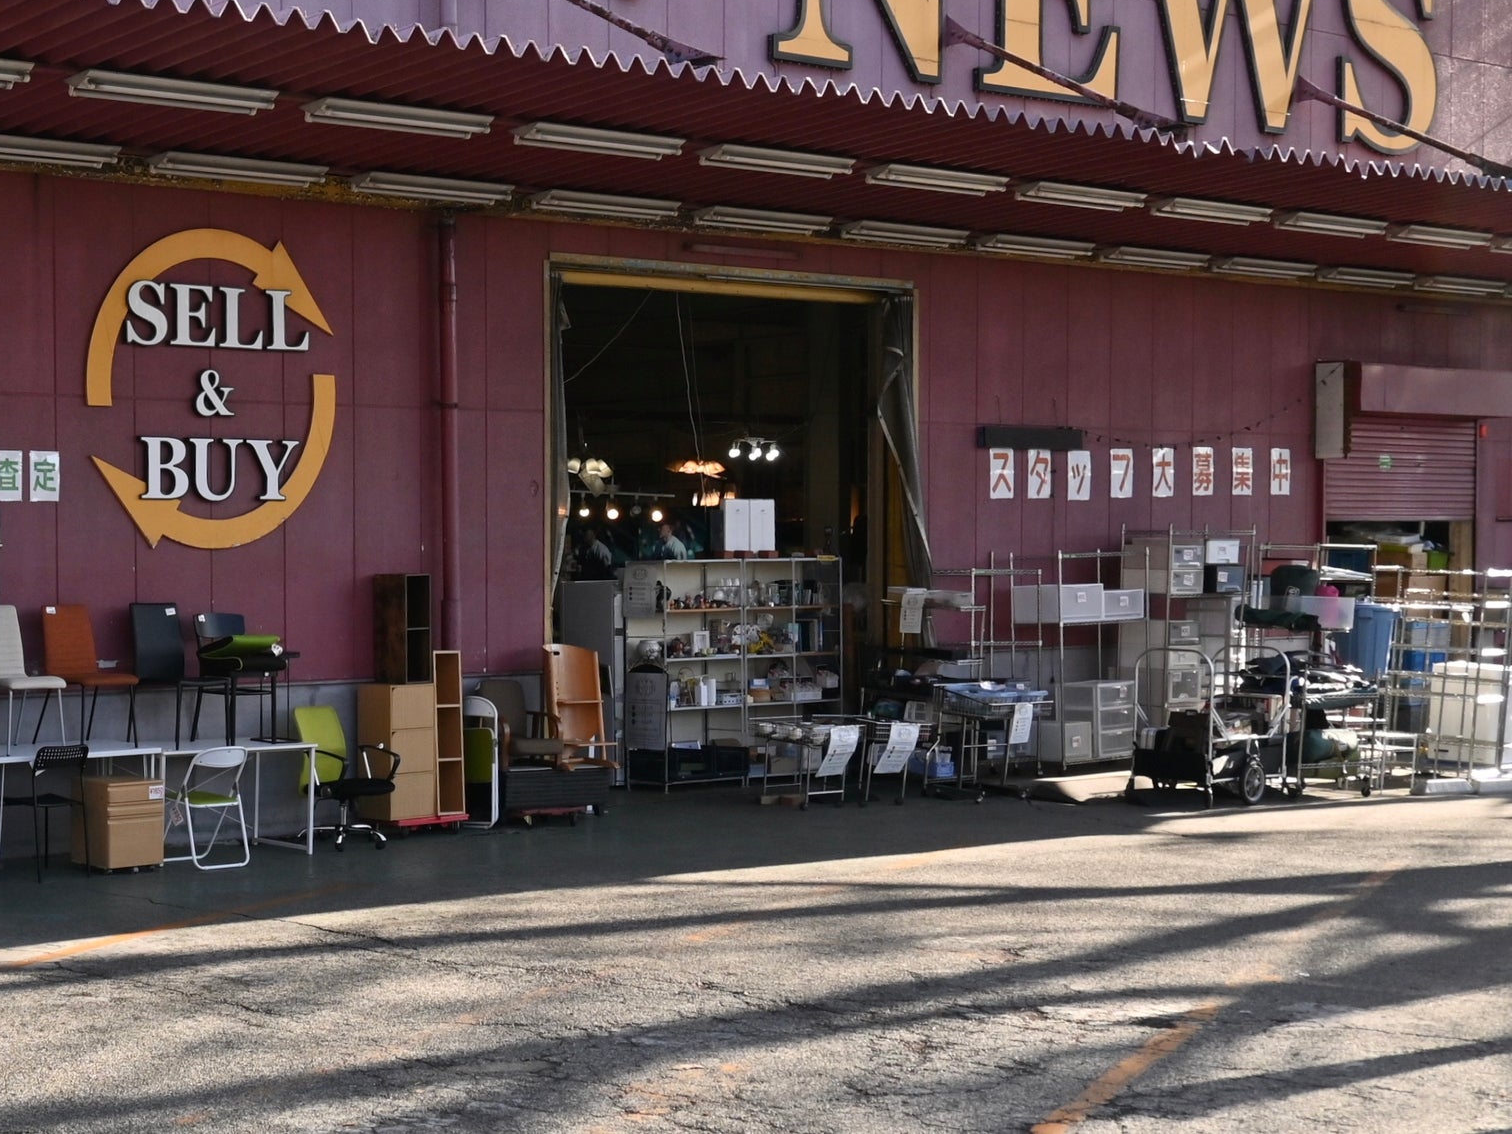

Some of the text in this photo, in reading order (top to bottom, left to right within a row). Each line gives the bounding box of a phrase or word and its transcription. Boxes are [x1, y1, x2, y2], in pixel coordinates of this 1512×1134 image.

[126, 279, 310, 352] SELL
[194, 369, 235, 417] &
[140, 436, 300, 502] BUY
[991, 450, 1290, 497] スタッフ大募集中
